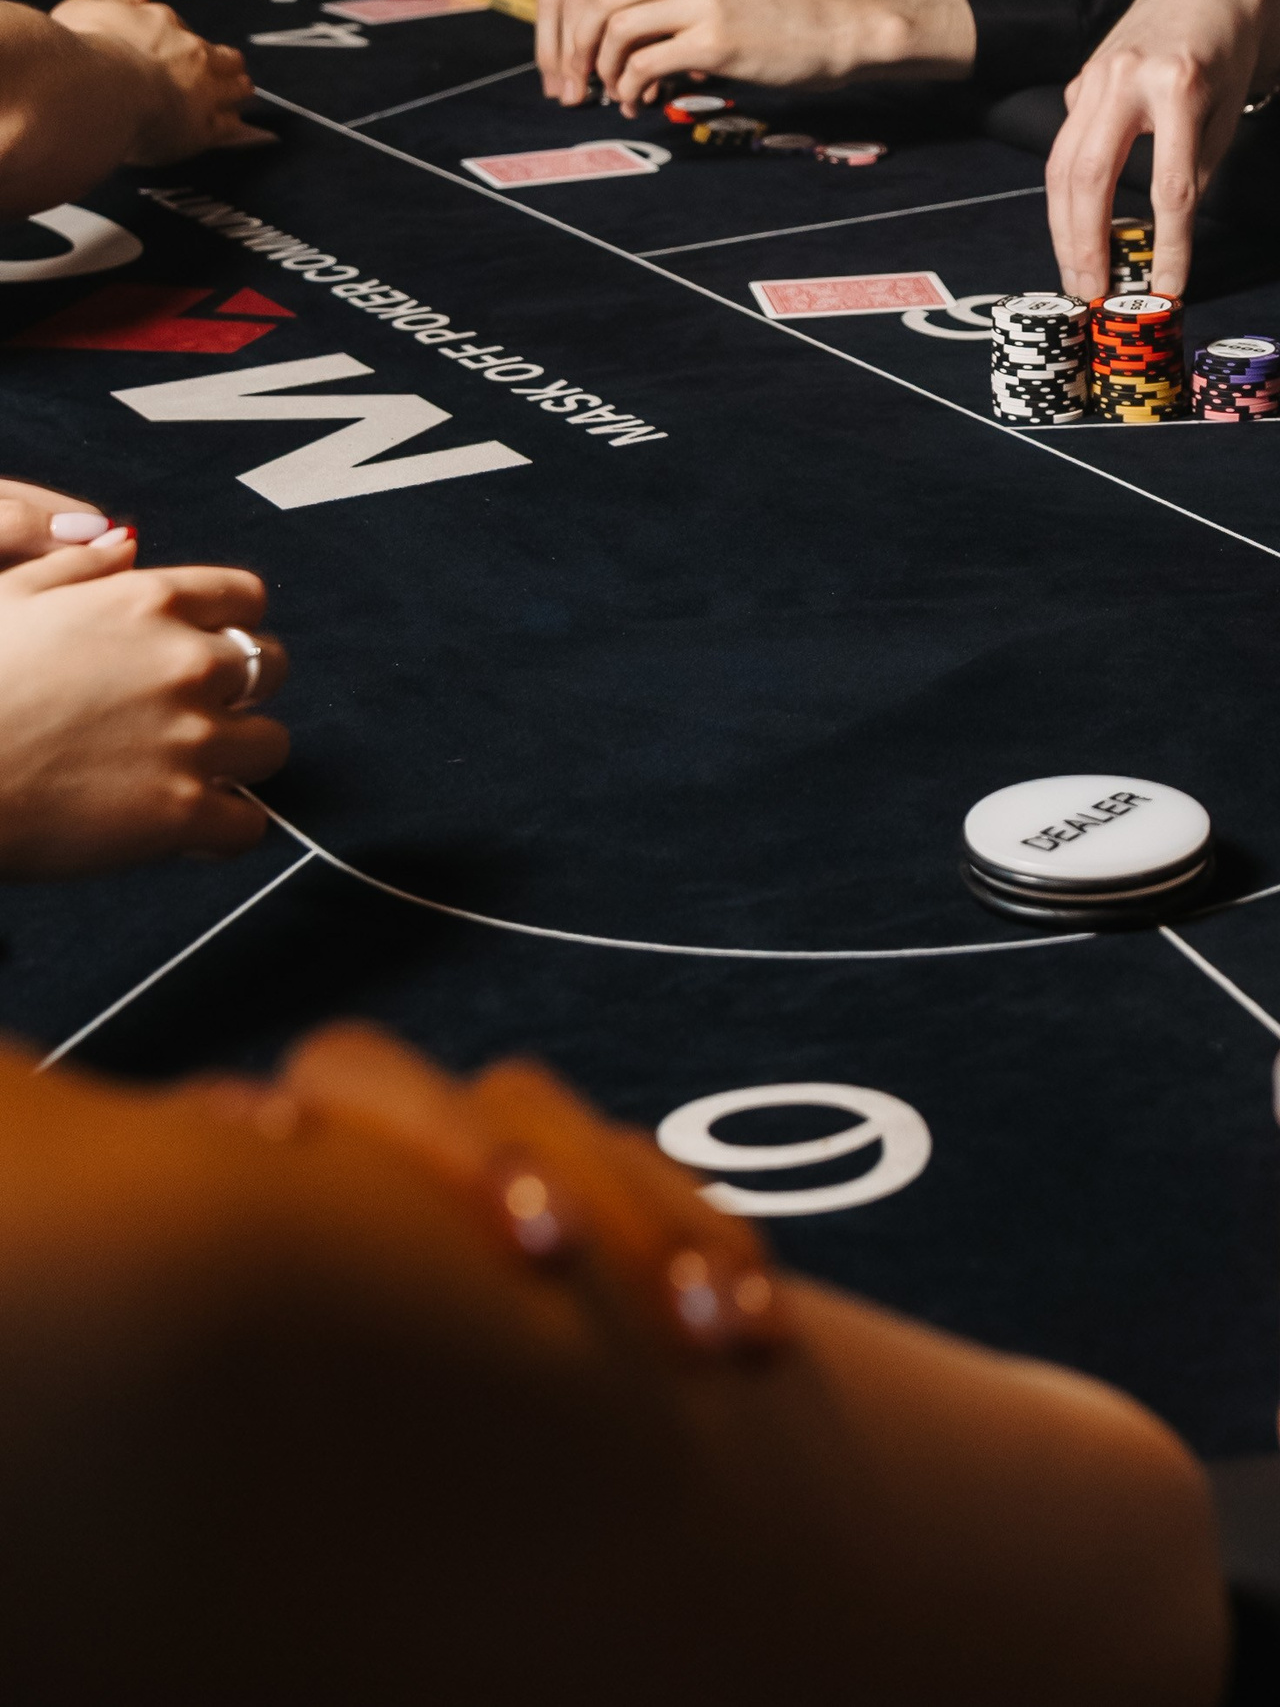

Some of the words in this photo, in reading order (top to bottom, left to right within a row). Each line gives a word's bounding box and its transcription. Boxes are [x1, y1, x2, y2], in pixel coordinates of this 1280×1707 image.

[248, 21, 370, 48] 4
[137, 186, 360, 283] COMMUNITY
[330, 278, 478, 344] POKER
[437, 344, 545, 382] OFF
[511, 379, 669, 447] MASK
[1020, 791, 1154, 852] DEALER
[656, 1081, 933, 1218] 9
